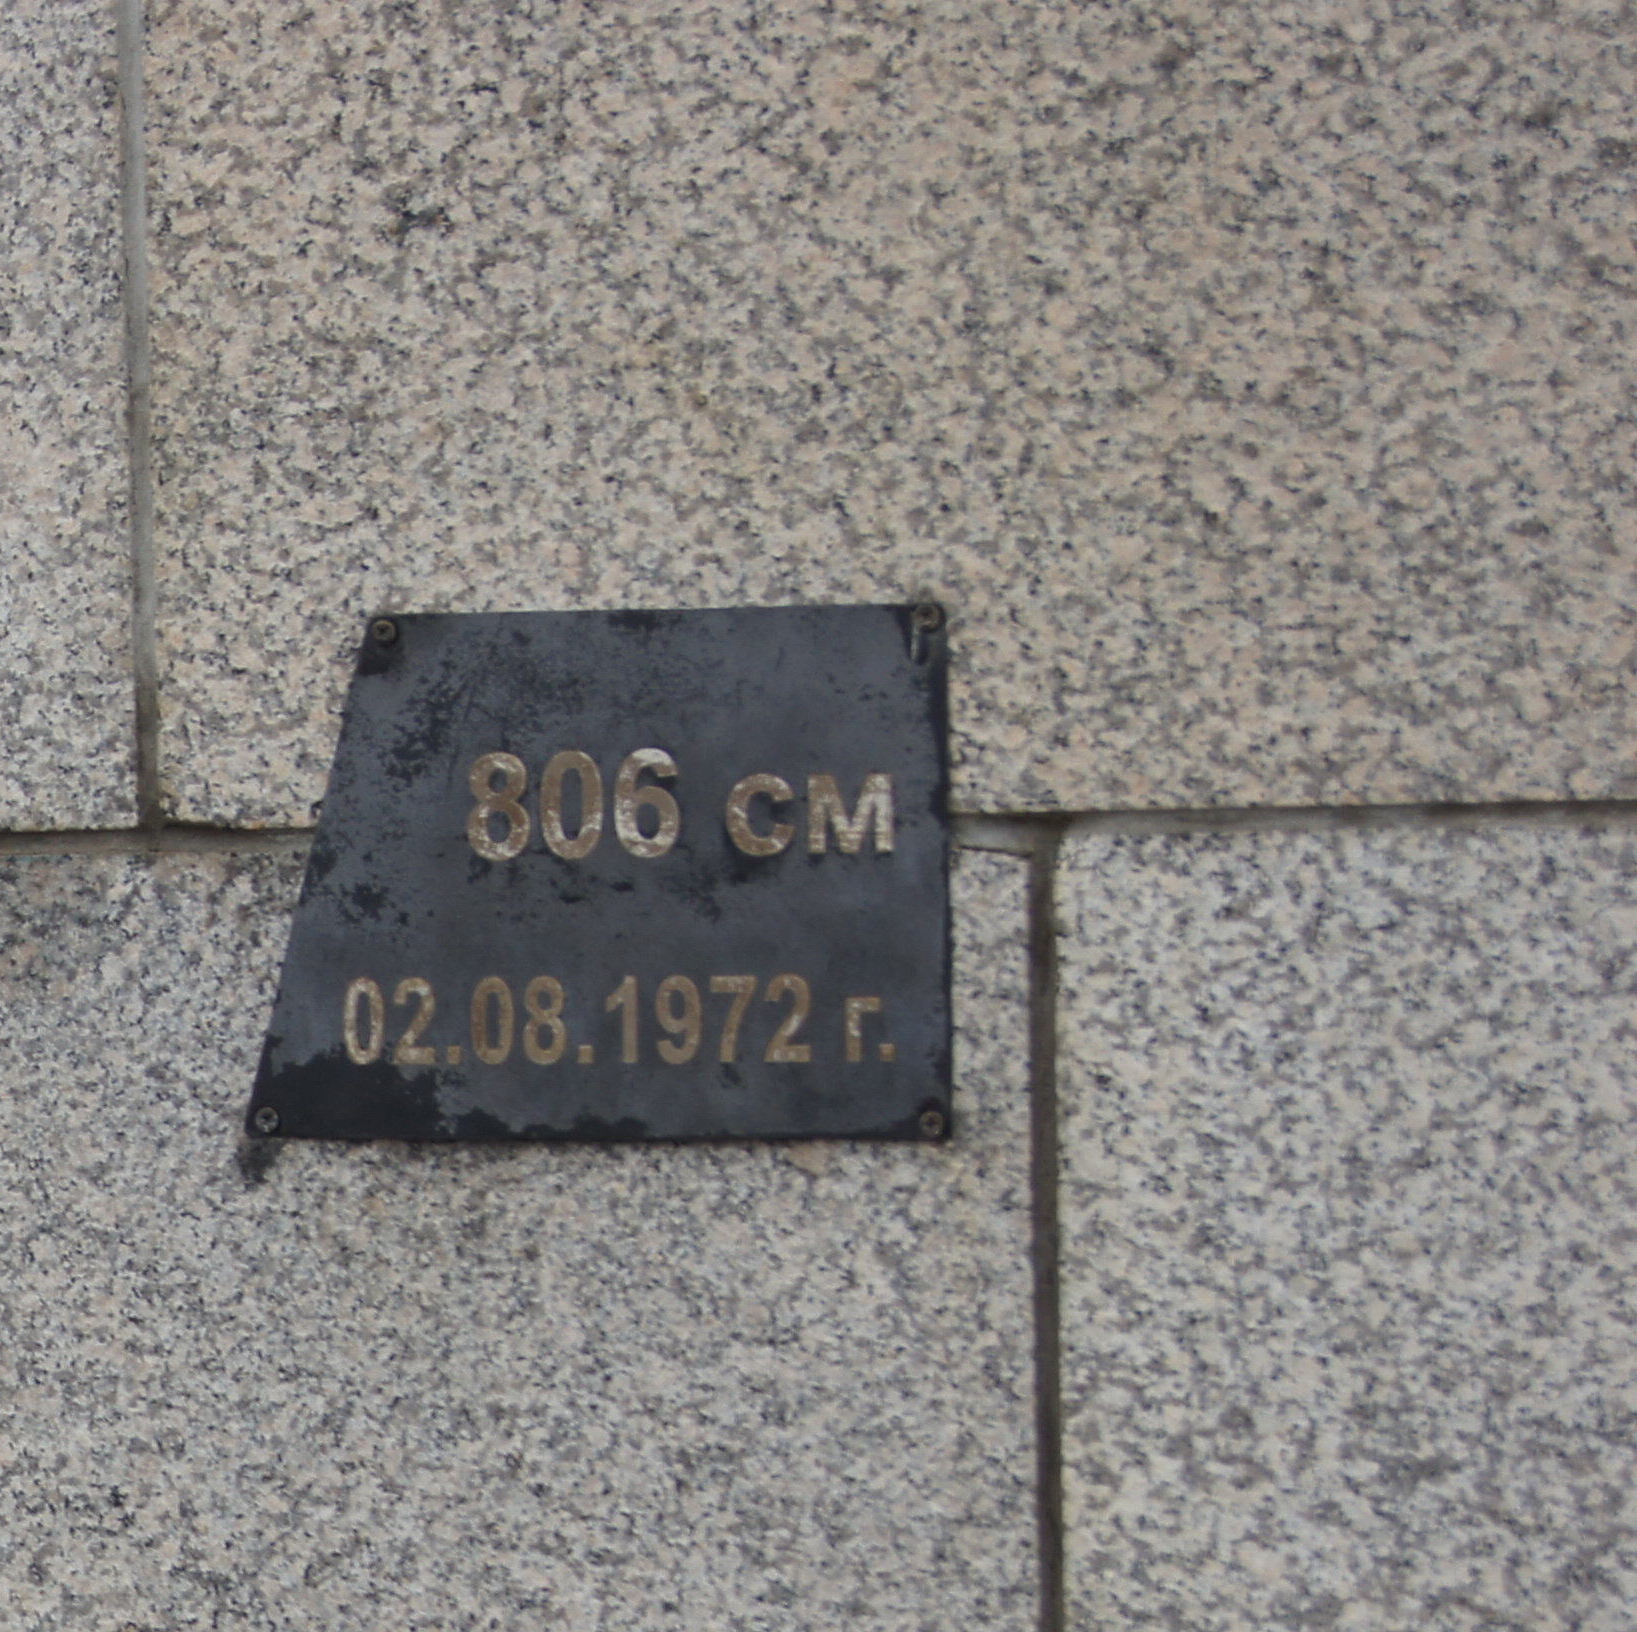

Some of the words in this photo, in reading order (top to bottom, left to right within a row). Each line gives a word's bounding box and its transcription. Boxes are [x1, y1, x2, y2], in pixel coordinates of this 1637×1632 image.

[466, 747, 682, 861] 806
[342, 974, 812, 1066] 02.08.1972
[844, 995, 896, 1063] г.
